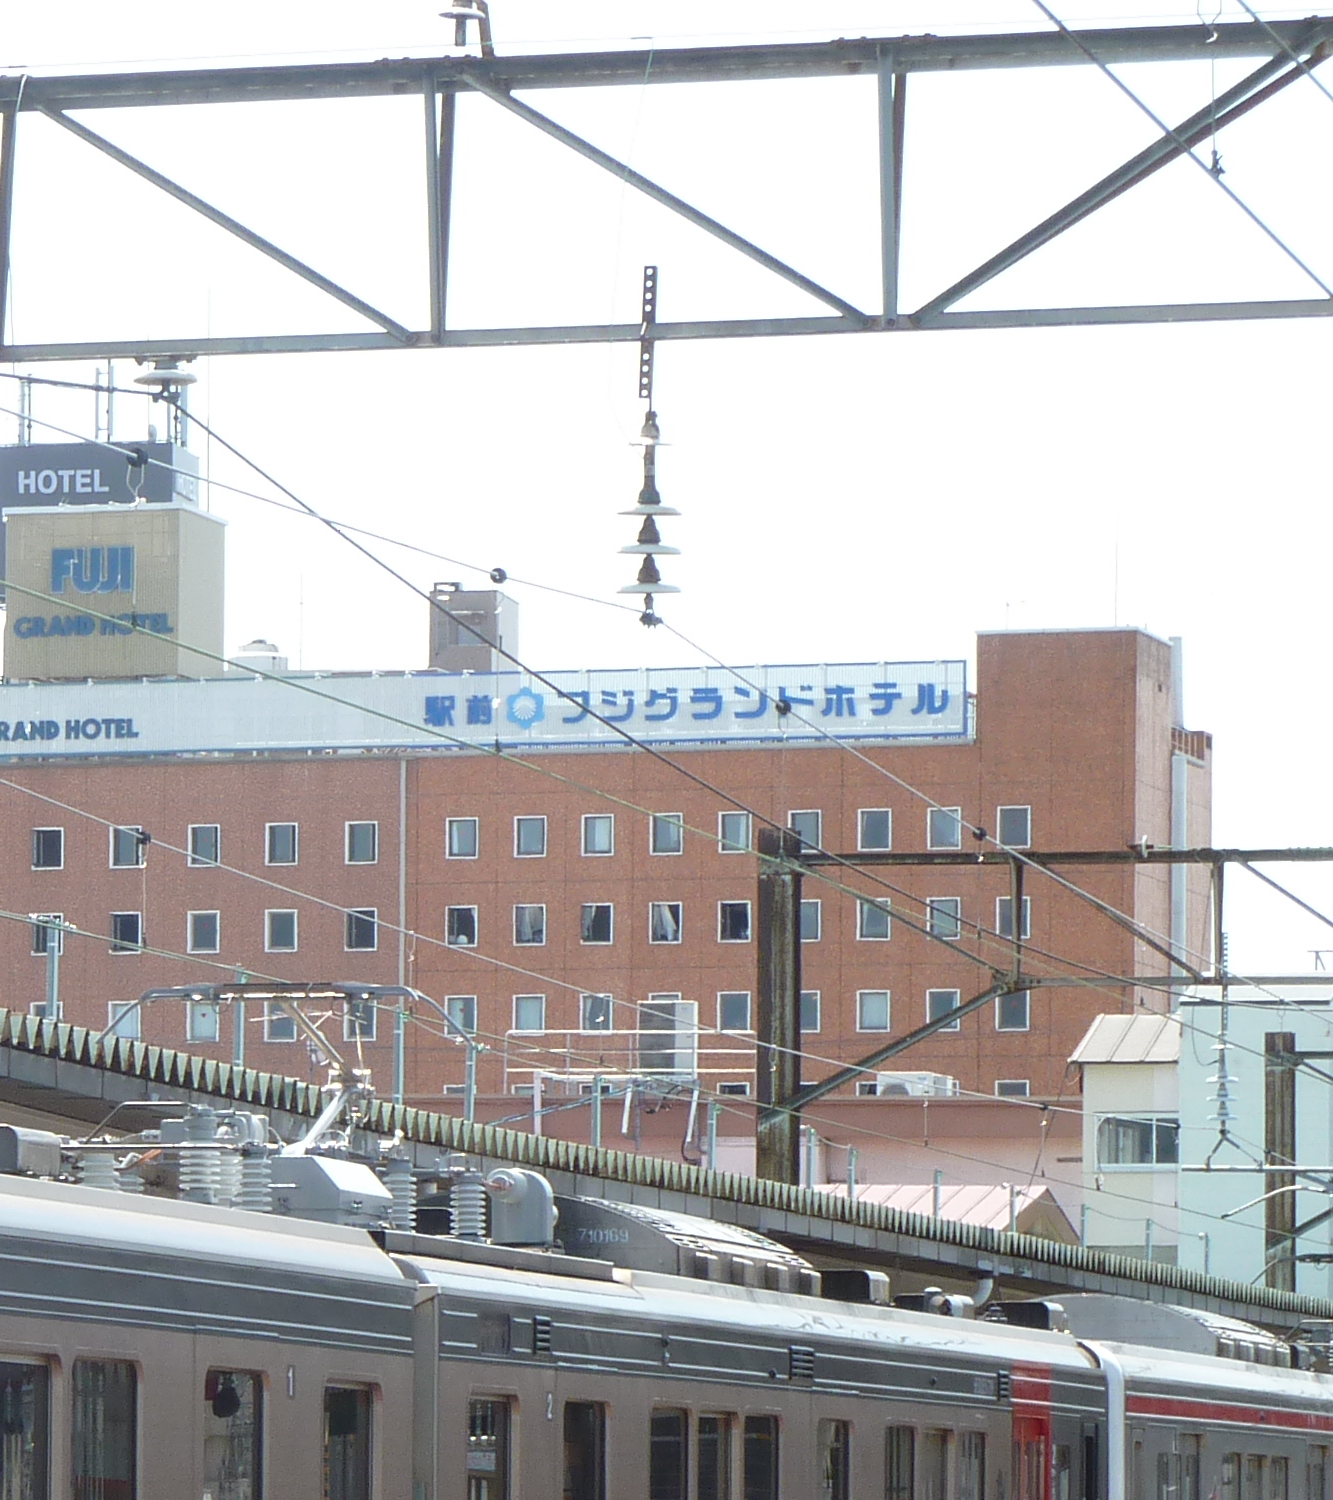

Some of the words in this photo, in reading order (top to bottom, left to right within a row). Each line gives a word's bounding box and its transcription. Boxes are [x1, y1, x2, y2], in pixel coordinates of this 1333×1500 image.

[18, 469, 110, 494] HOTEL
[51, 545, 135, 594] FUJI
[13, 614, 96, 639] GRAND
[99, 612, 174, 636] HOTEL
[424, 694, 493, 727] 駅前
[556, 681, 949, 725] フジグランドホテル
[65, 718, 140, 740] HOTEL
[578, 1227, 630, 1244] 710169
[287, 1366, 294, 1397] 1
[546, 1392, 554, 1420] 2
